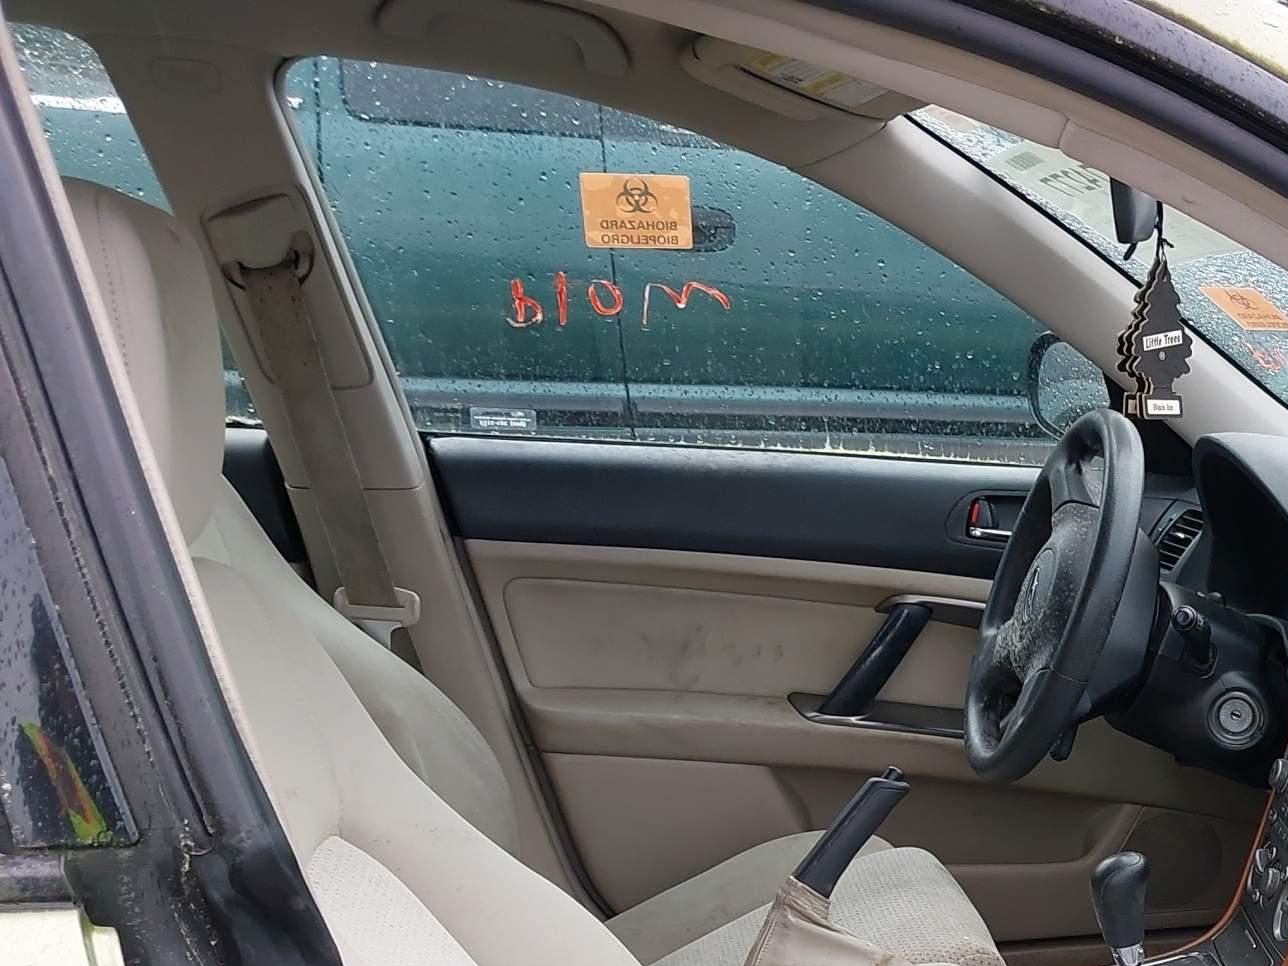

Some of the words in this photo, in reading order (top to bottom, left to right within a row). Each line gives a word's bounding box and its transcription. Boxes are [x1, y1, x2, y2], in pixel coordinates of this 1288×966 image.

[1146, 335, 1162, 349] Little
[1163, 333, 1181, 345] Trees
[1153, 403, 1166, 411] Black
